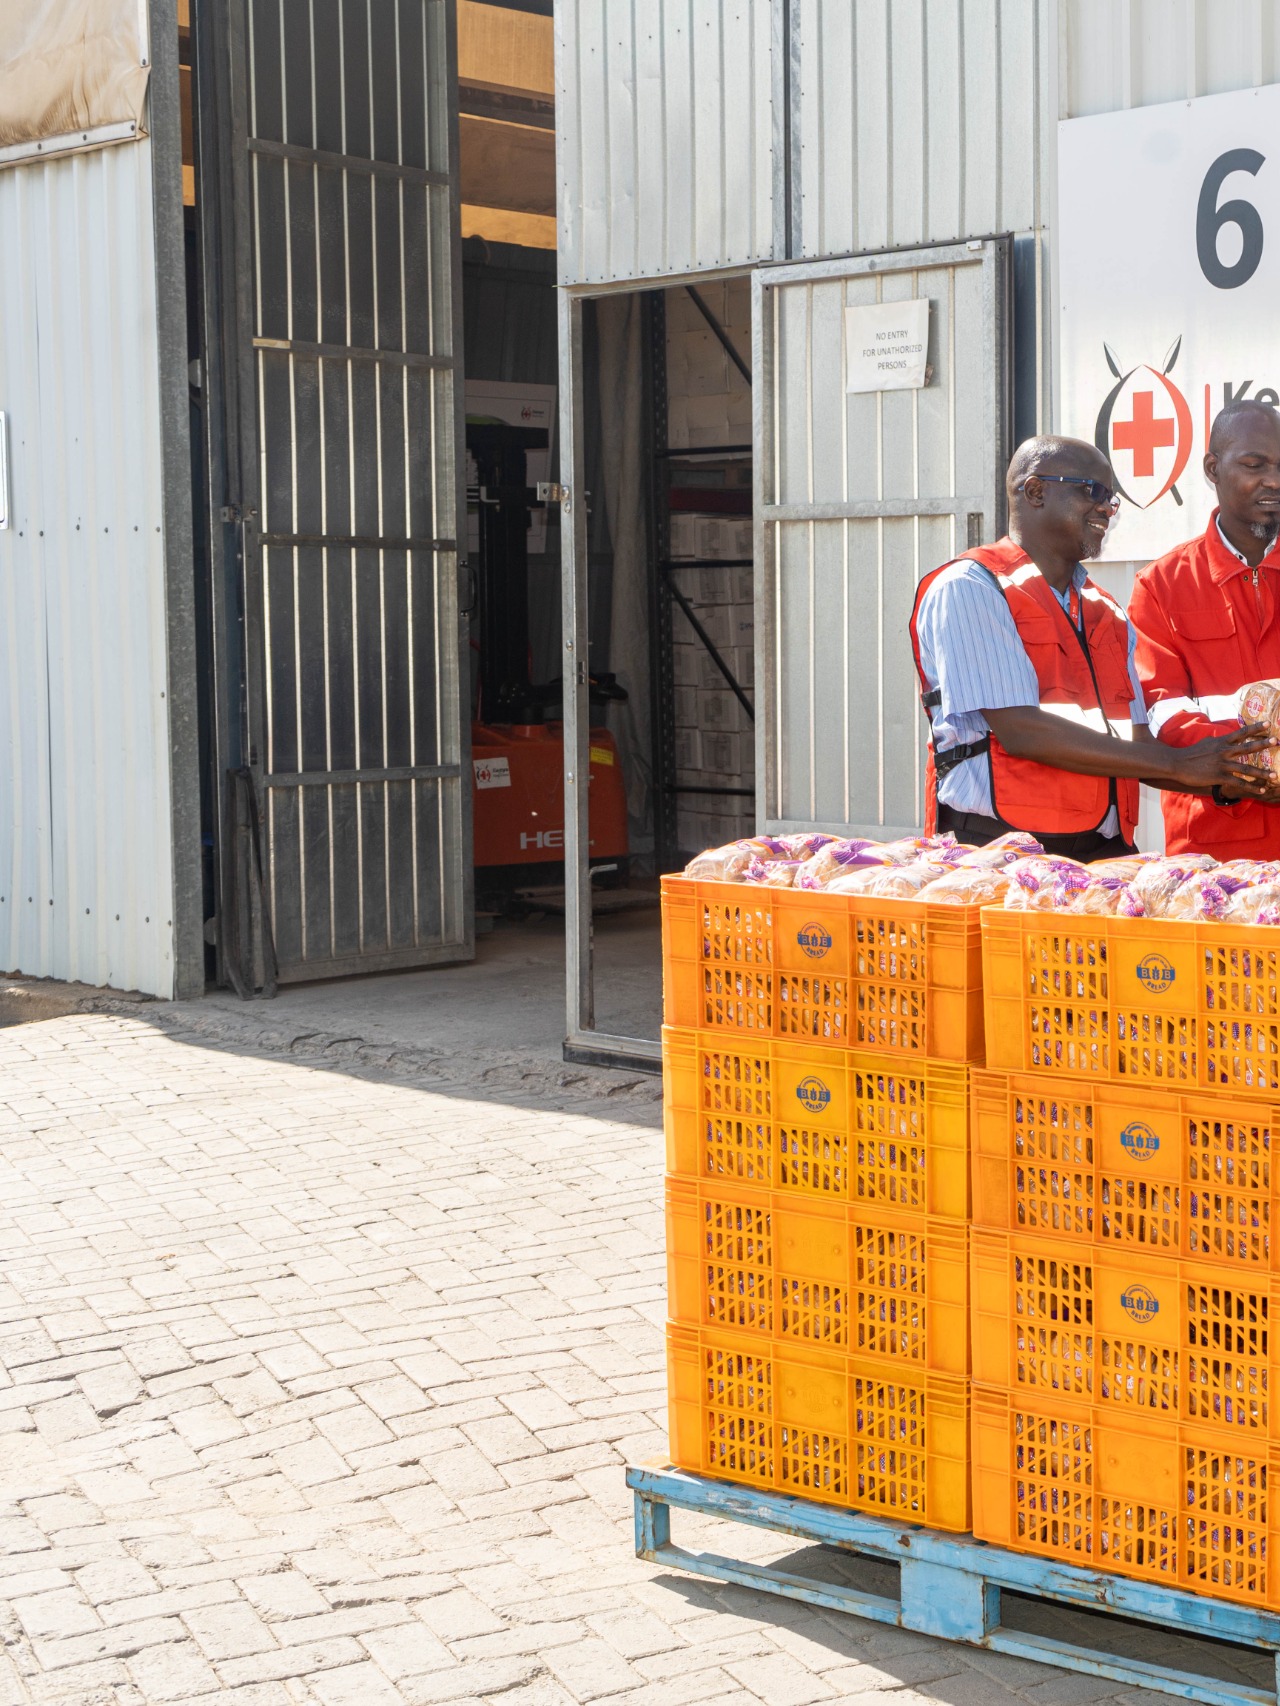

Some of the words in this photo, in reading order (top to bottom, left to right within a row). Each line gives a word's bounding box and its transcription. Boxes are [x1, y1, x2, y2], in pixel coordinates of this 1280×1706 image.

[1196, 148, 1266, 289] 6
[876, 332, 887, 341] NO
[888, 330, 908, 340] ENTRY
[863, 349, 876, 357] FOR
[877, 344, 923, 356] UNATHORIZED
[878, 360, 907, 370] PERSONS
[520, 830, 563, 850] HE
